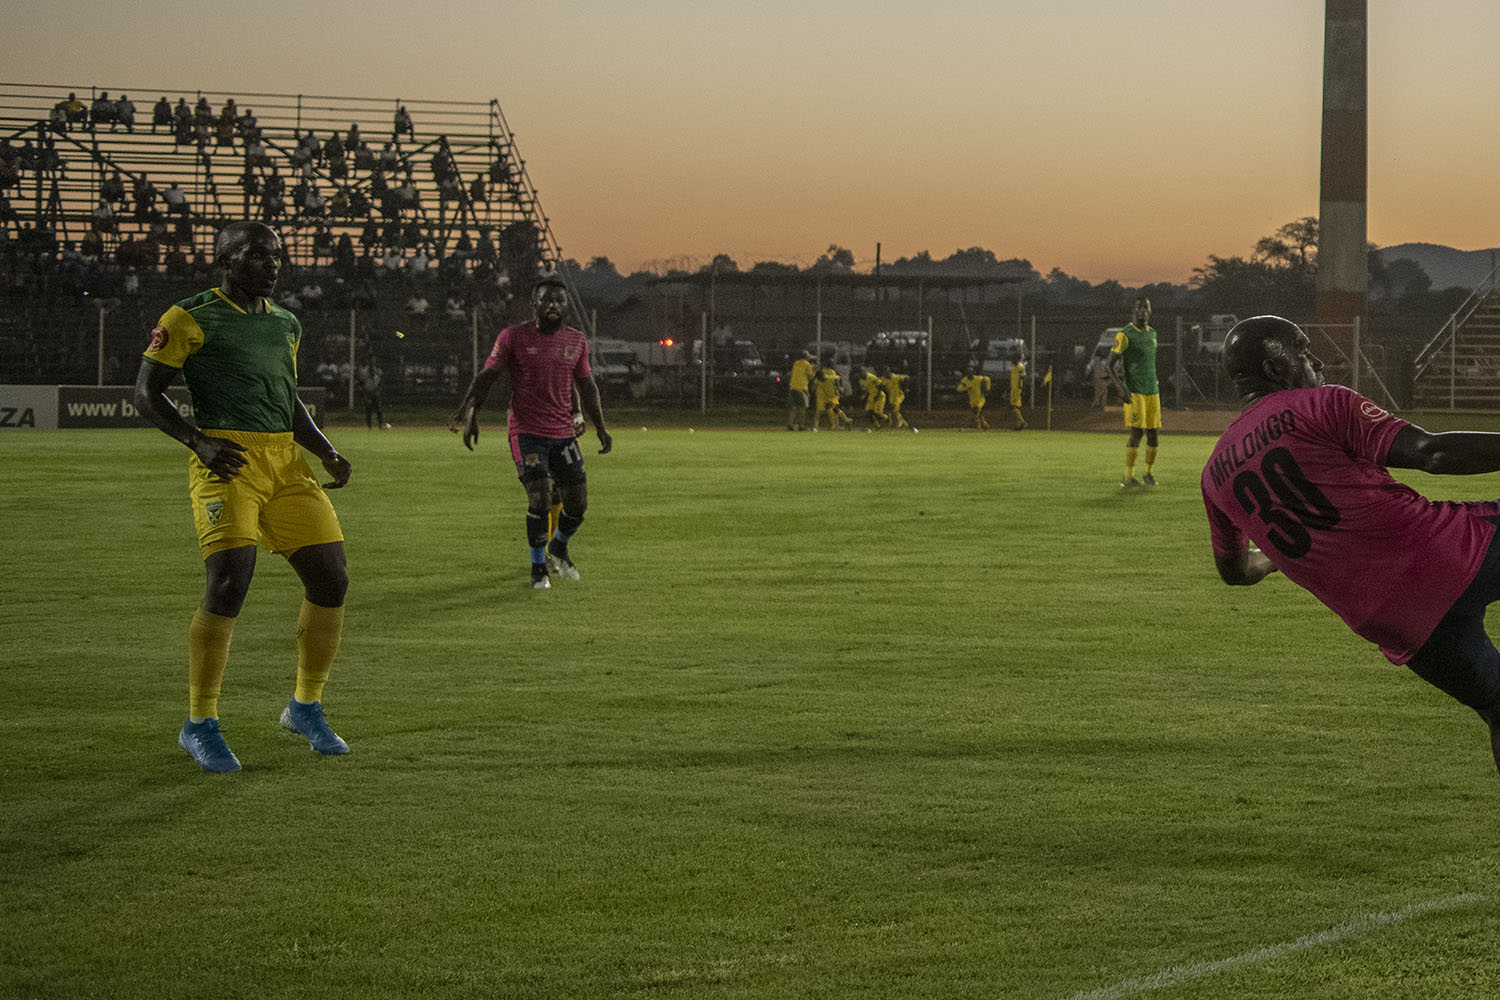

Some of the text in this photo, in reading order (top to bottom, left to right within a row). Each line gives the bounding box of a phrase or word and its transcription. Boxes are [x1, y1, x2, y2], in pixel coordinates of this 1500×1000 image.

[560, 442, 582, 465] 11
[1209, 409, 1296, 491] MHLONGO
[1232, 446, 1341, 559] 30
